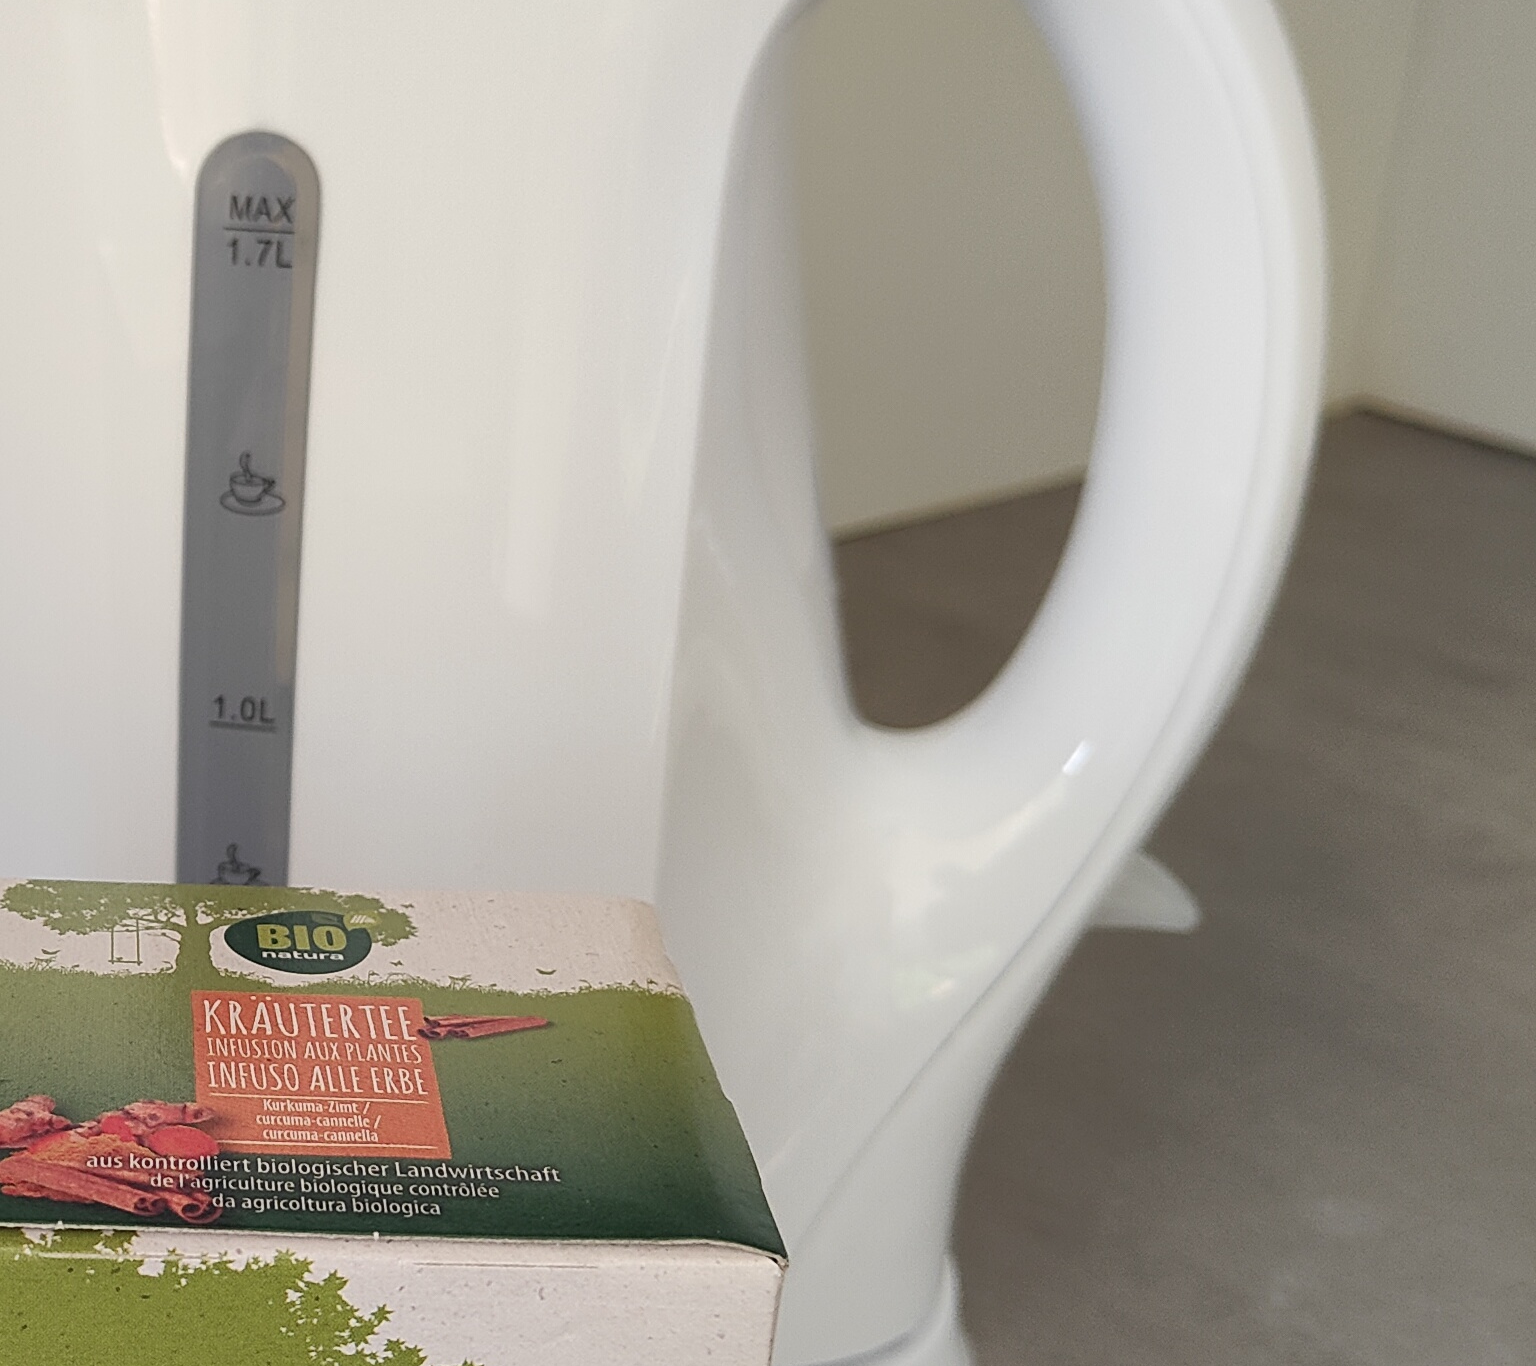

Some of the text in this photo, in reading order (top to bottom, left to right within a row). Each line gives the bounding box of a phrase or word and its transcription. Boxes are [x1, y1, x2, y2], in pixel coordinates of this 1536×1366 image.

[229, 196, 295, 225] MAX
[226, 239, 294, 268] 1.7L
[214, 696, 275, 722] 1.0L
[256, 923, 347, 951] BIO
[262, 949, 344, 961] natura
[203, 995, 417, 1041] KRÄUTERTEE
[207, 1037, 422, 1065] INFUSION AUX PLANTES
[207, 1061, 429, 1095] INFUSO ALLE ERBE
[263, 1098, 359, 1113] Kurkuma-Zimt
[256, 1113, 371, 1128] curcuma-cannelle
[263, 1129, 379, 1143] curcuma-cannella
[86, 1153, 562, 1183] aus kontrolliert biologischer Landwirtschaft
[150, 1173, 500, 1198] de l'agriculture biologique contrôlée
[212, 1193, 441, 1218] da agricoltura biologica
